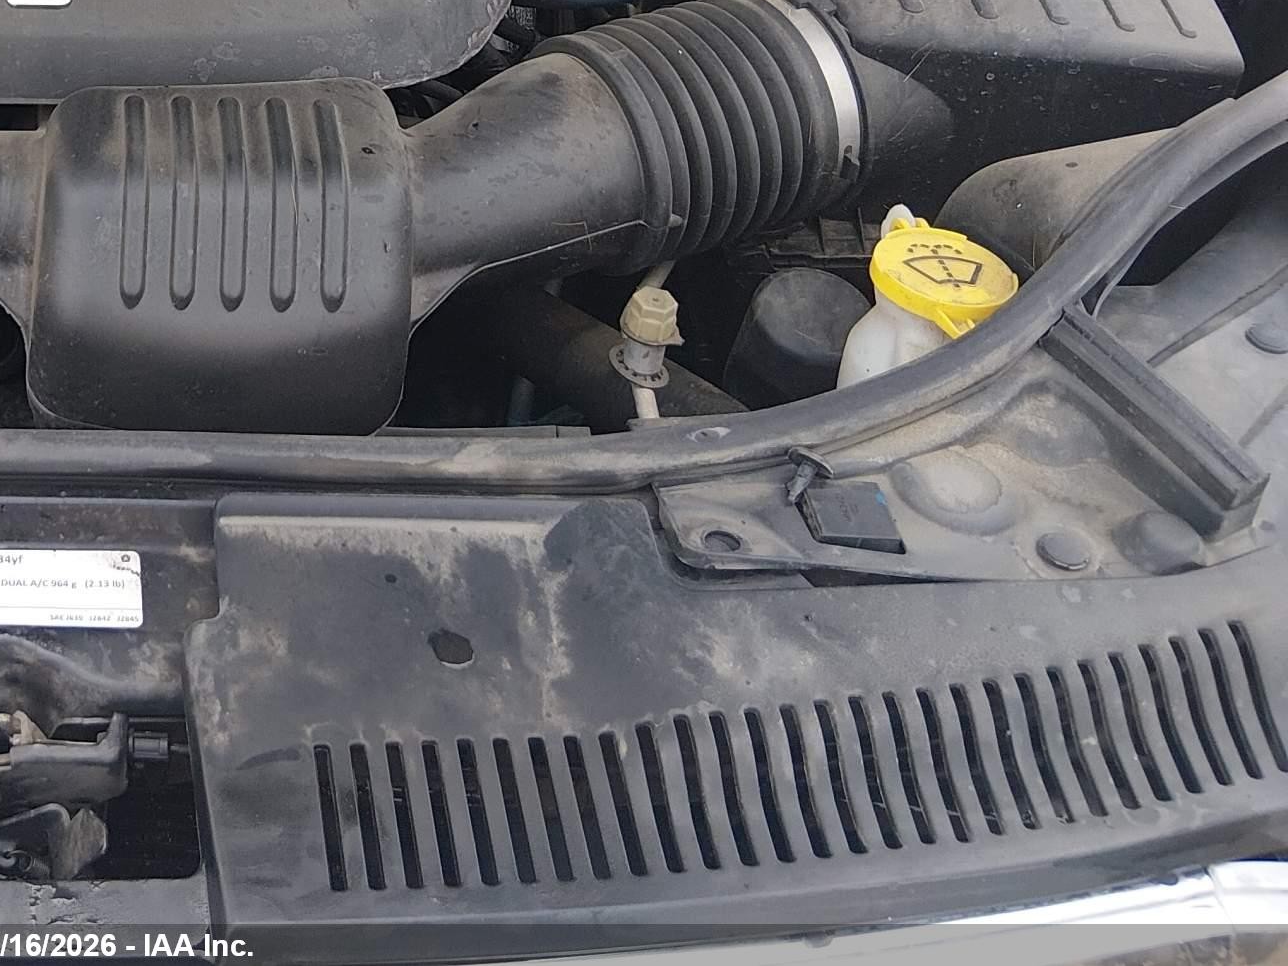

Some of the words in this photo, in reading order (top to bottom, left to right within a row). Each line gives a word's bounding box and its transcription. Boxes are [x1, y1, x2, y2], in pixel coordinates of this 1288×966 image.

[0, 578, 28, 587] DUAL
[30, 578, 49, 588] A/C
[85, 579, 109, 589] (2.13
[112, 578, 125, 589] lb)
